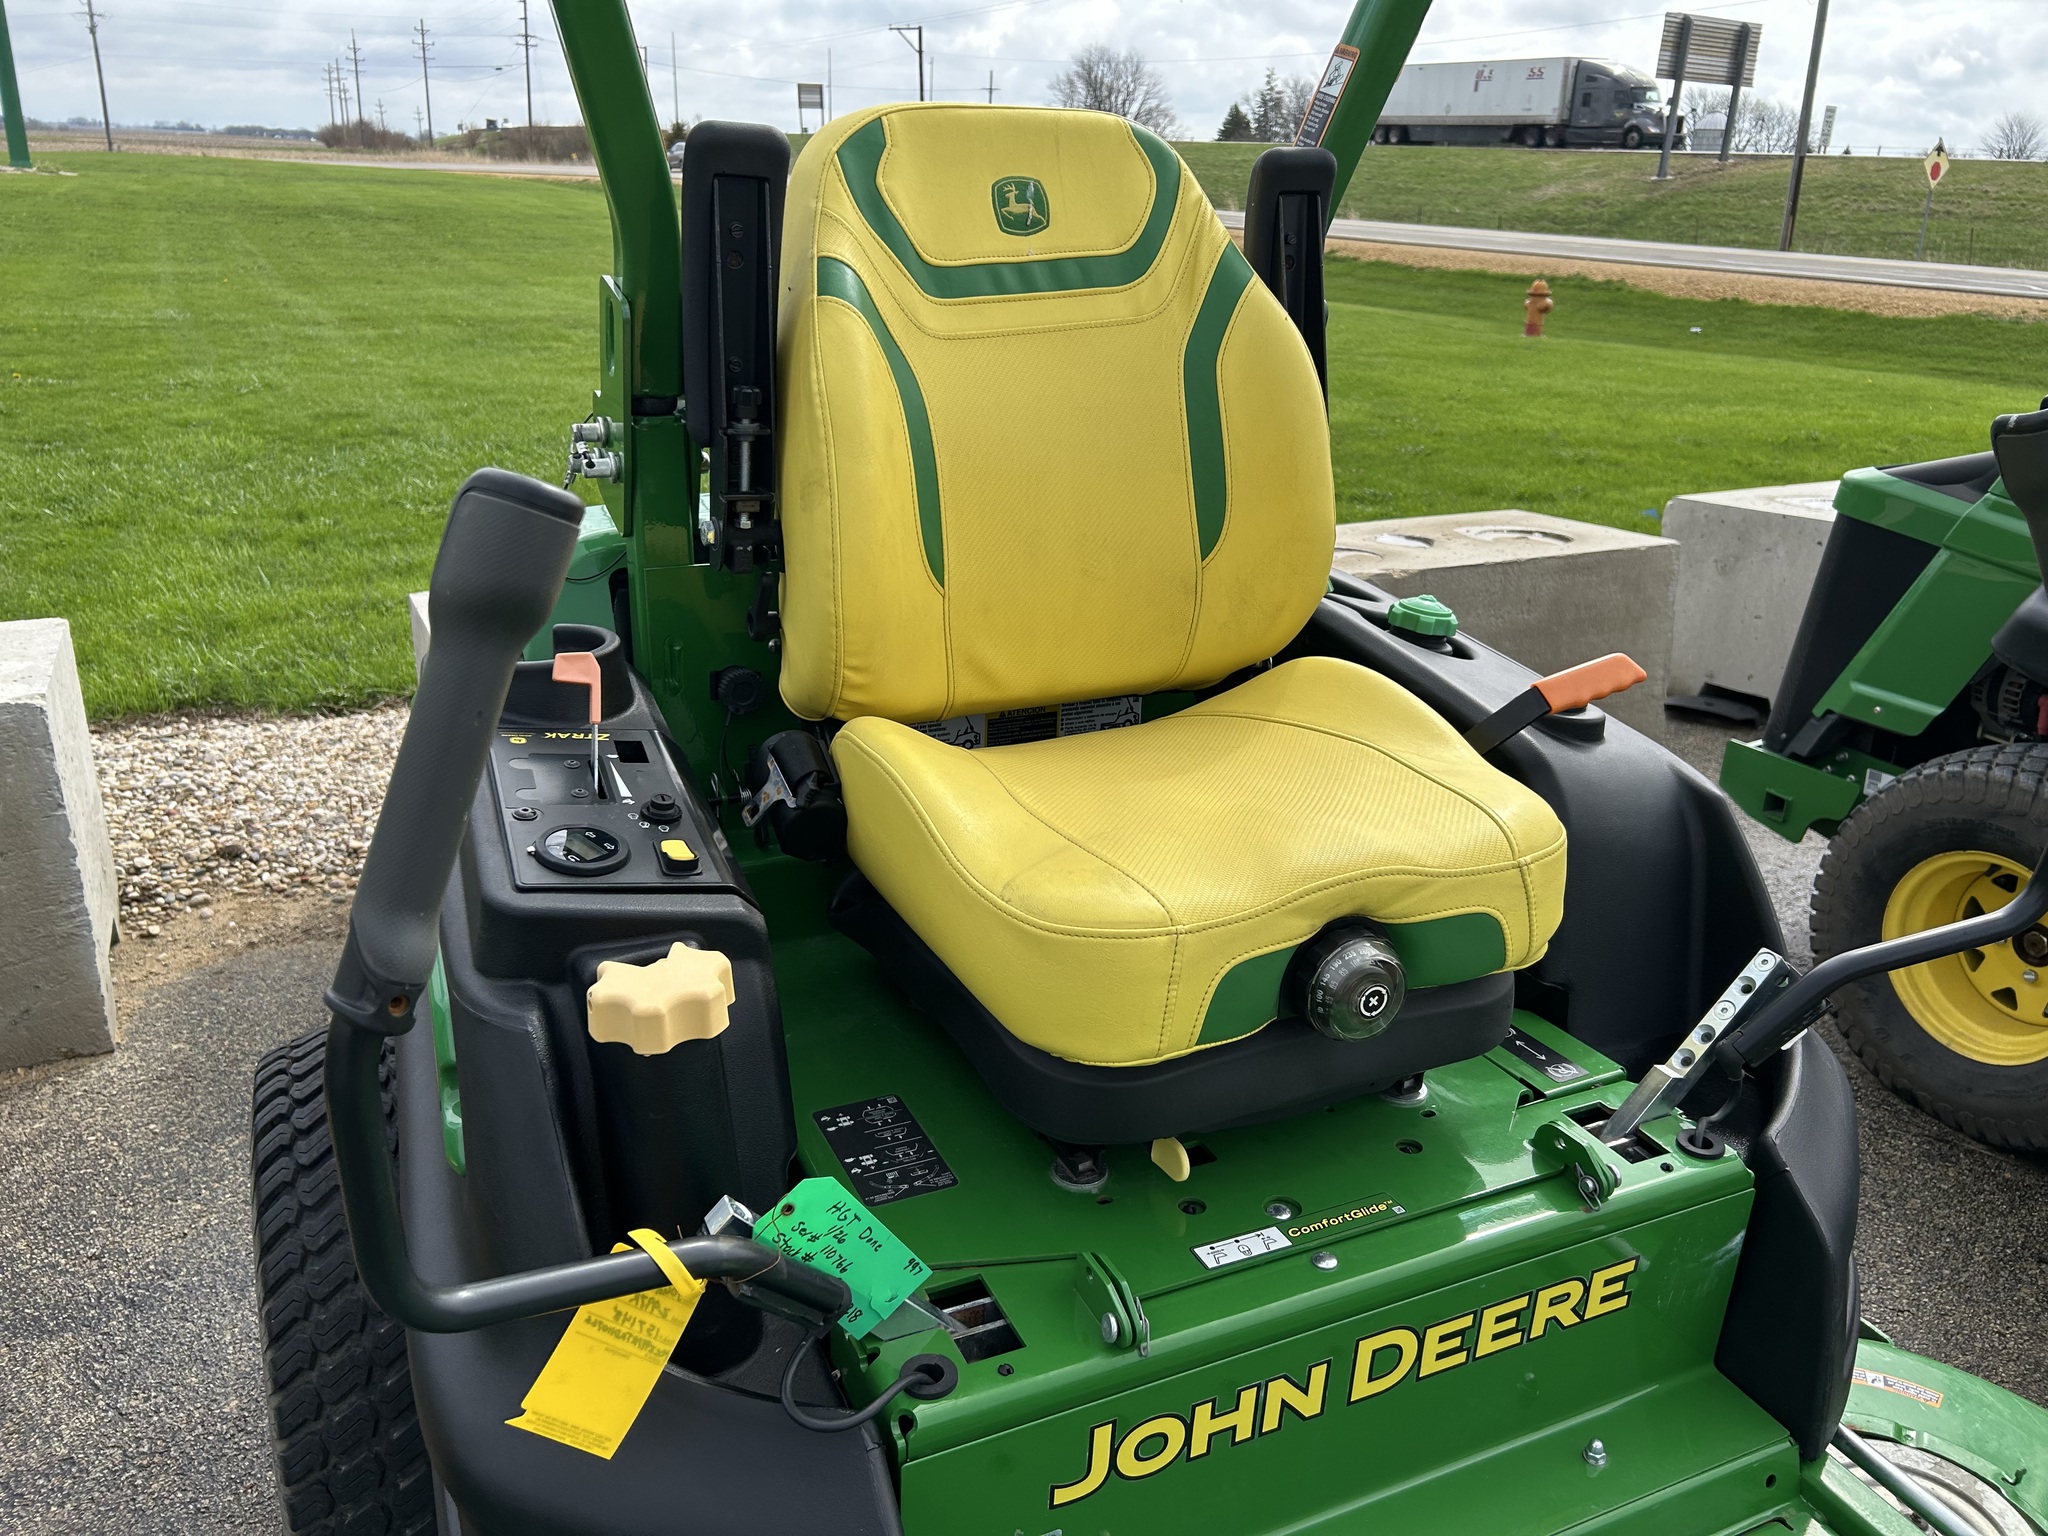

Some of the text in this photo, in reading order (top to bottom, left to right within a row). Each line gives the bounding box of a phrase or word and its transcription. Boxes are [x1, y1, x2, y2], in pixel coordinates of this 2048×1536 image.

[858, 1226, 883, 1252] Done
[820, 1244, 853, 1274] 110766
[903, 1257, 923, 1276] 997
[1050, 1255, 1640, 1509] JOHN DEERE
